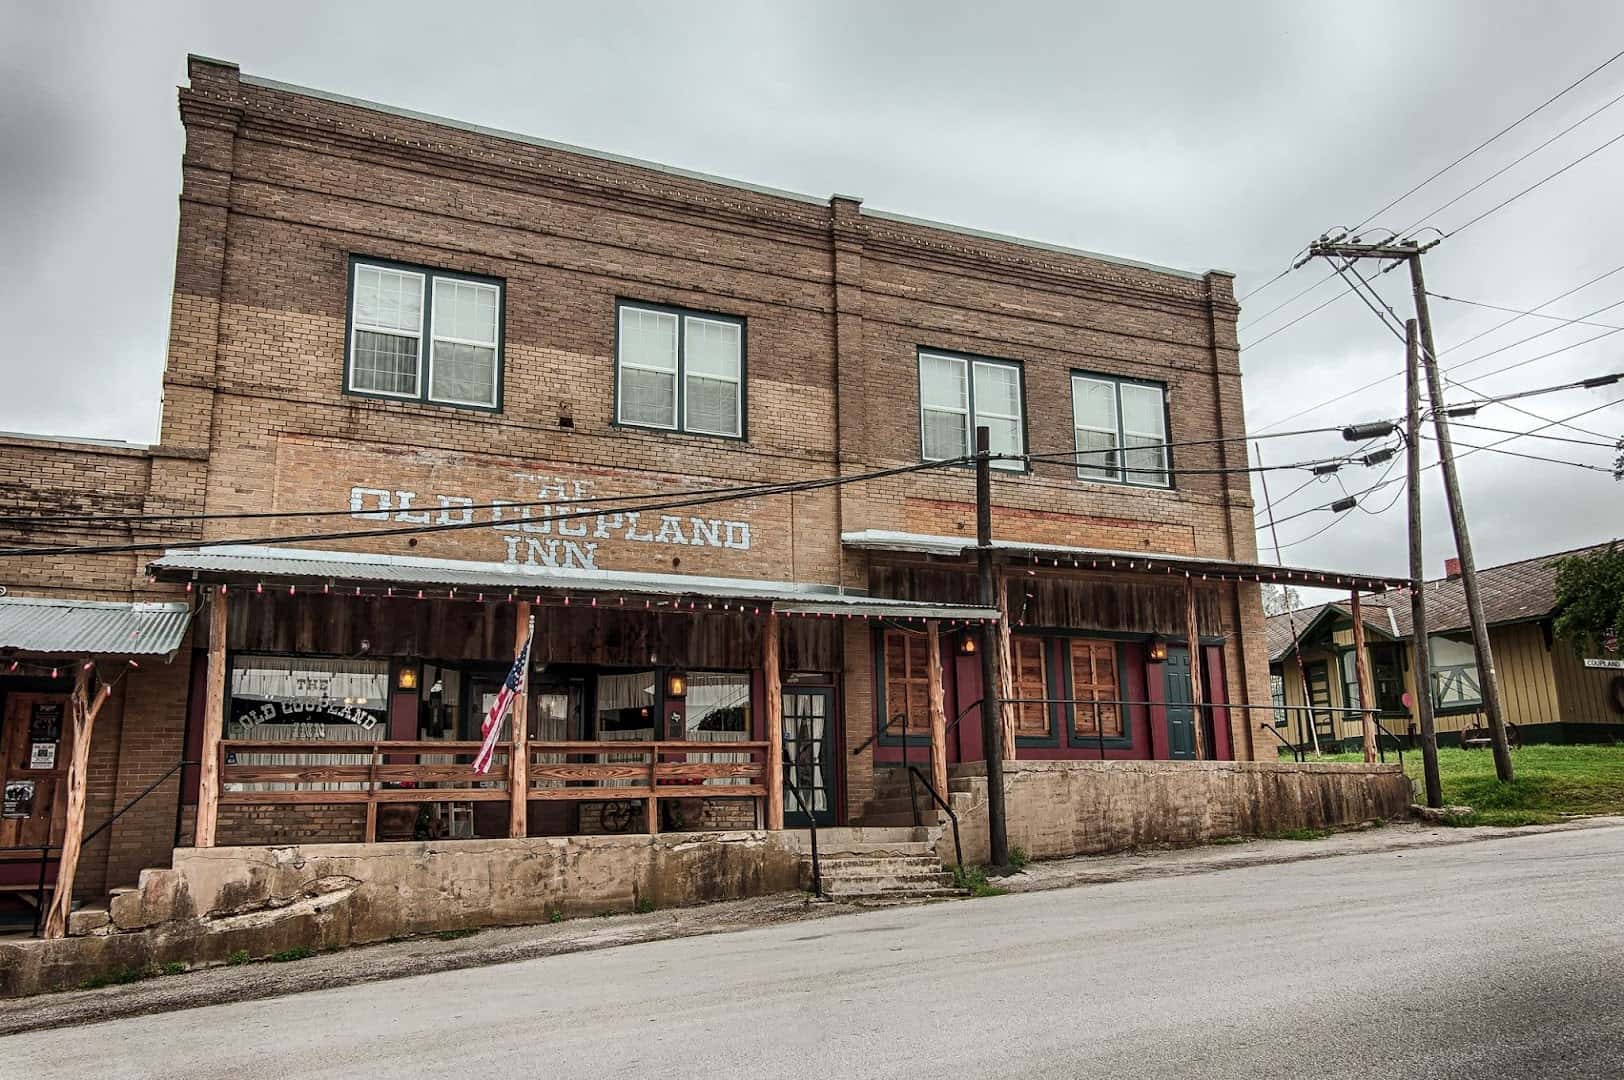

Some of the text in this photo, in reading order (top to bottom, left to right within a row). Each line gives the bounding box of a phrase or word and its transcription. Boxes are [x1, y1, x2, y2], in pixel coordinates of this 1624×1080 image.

[349, 487, 751, 549] OLD COUPLAND
[503, 535, 599, 569] INN
[297, 678, 329, 691] THE
[239, 698, 377, 730] OLD COUPLAND
[292, 722, 326, 738] INN
